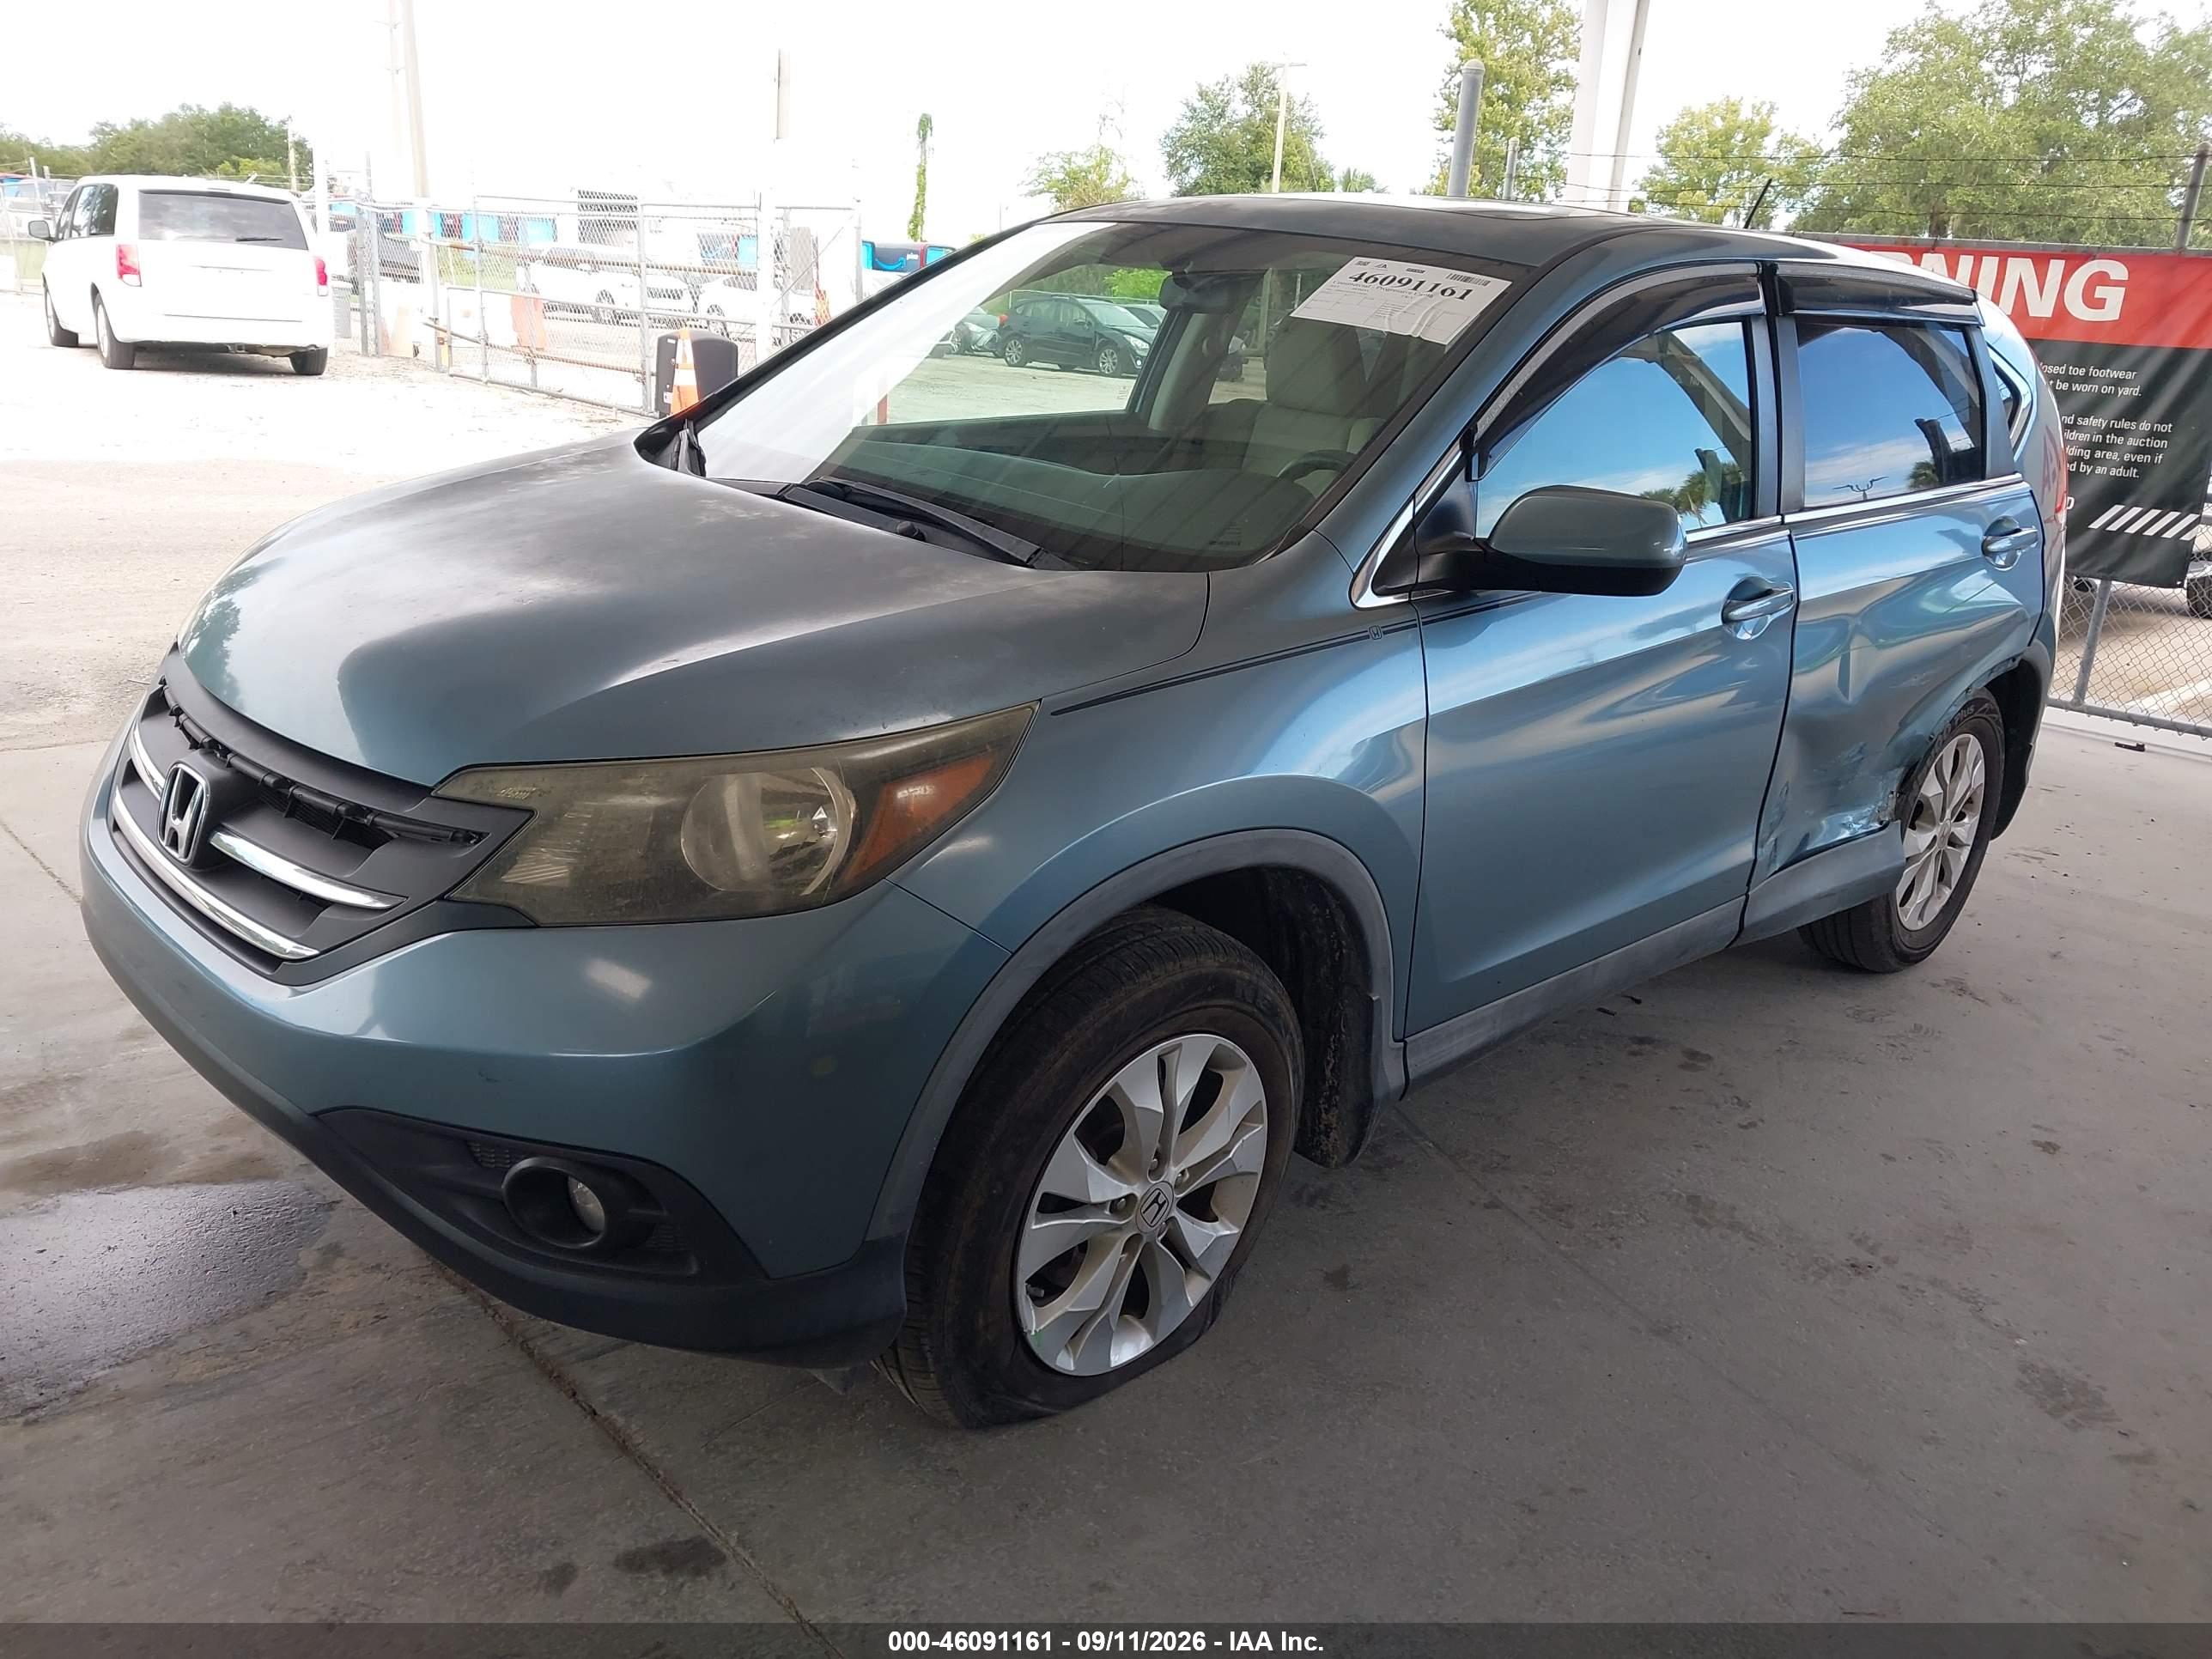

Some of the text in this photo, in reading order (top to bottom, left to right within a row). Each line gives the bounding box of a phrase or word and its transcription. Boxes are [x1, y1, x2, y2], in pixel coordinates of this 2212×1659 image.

[1349, 272, 1473, 301] 46091161
[2069, 365, 2086, 376] toe
[2088, 366, 2137, 380] footwear
[2056, 380, 2069, 391] be
[2071, 384, 2098, 393] worn
[2101, 386, 2114, 394] on
[2118, 386, 2142, 398] yard.
[2061, 414, 2173, 433] nd safety rules do not
[2063, 428, 2168, 449] ildren in the auction
[2094, 449, 2121, 462] area,
[2124, 453, 2152, 464] even
[2154, 453, 2165, 465] if
[2079, 461, 2094, 476] by
[2095, 465, 2107, 475] an
[2109, 466, 2140, 478] adult.
